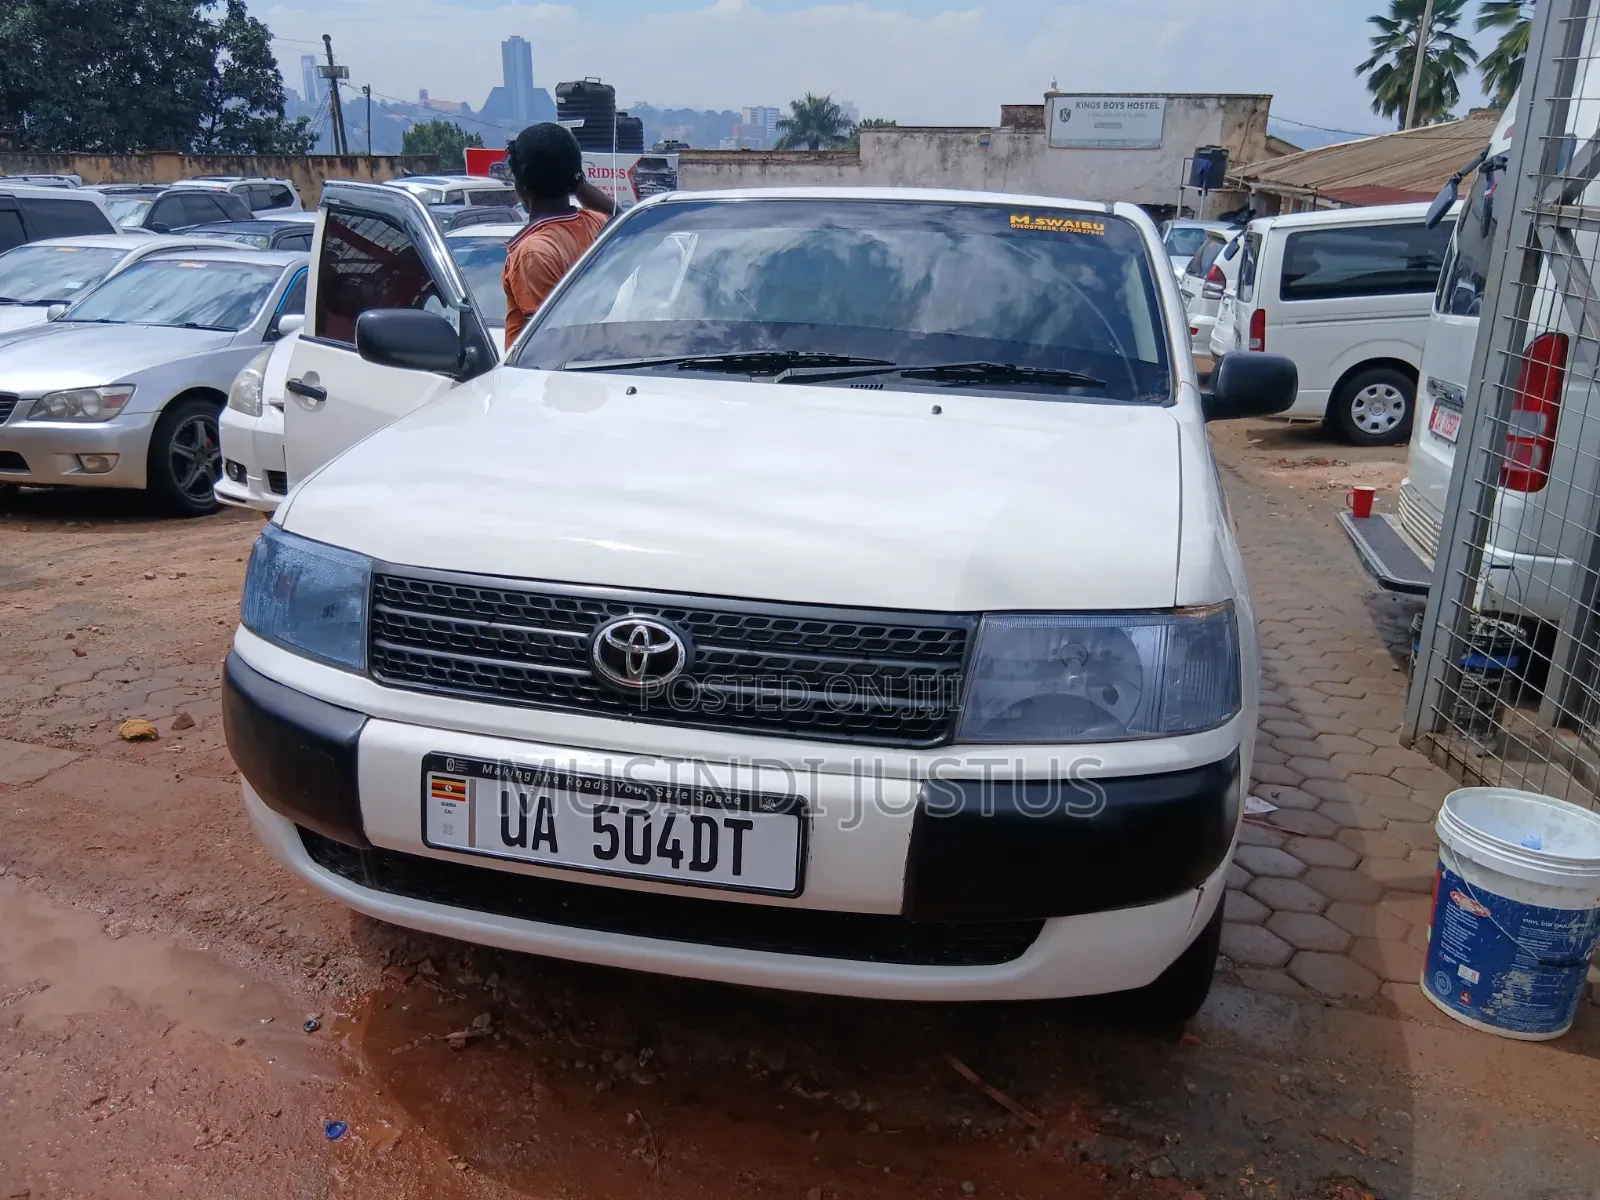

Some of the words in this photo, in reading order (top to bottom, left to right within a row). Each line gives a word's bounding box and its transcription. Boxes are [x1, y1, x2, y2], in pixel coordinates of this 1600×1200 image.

[1075, 101, 1101, 110] KINGS
[1103, 101, 1125, 110] BOYS
[1127, 101, 1160, 110] HOSTEL
[588, 168, 626, 179] RIDES
[1010, 215, 1105, 231] M.SWAIBU
[482, 764, 532, 781] Making
[537, 771, 560, 784] the
[566, 775, 609, 791] Roads
[616, 782, 650, 796] Your
[655, 786, 689, 800] Safe
[695, 791, 741, 805] Space
[501, 789, 559, 854] UA
[592, 803, 754, 876] 504DT
